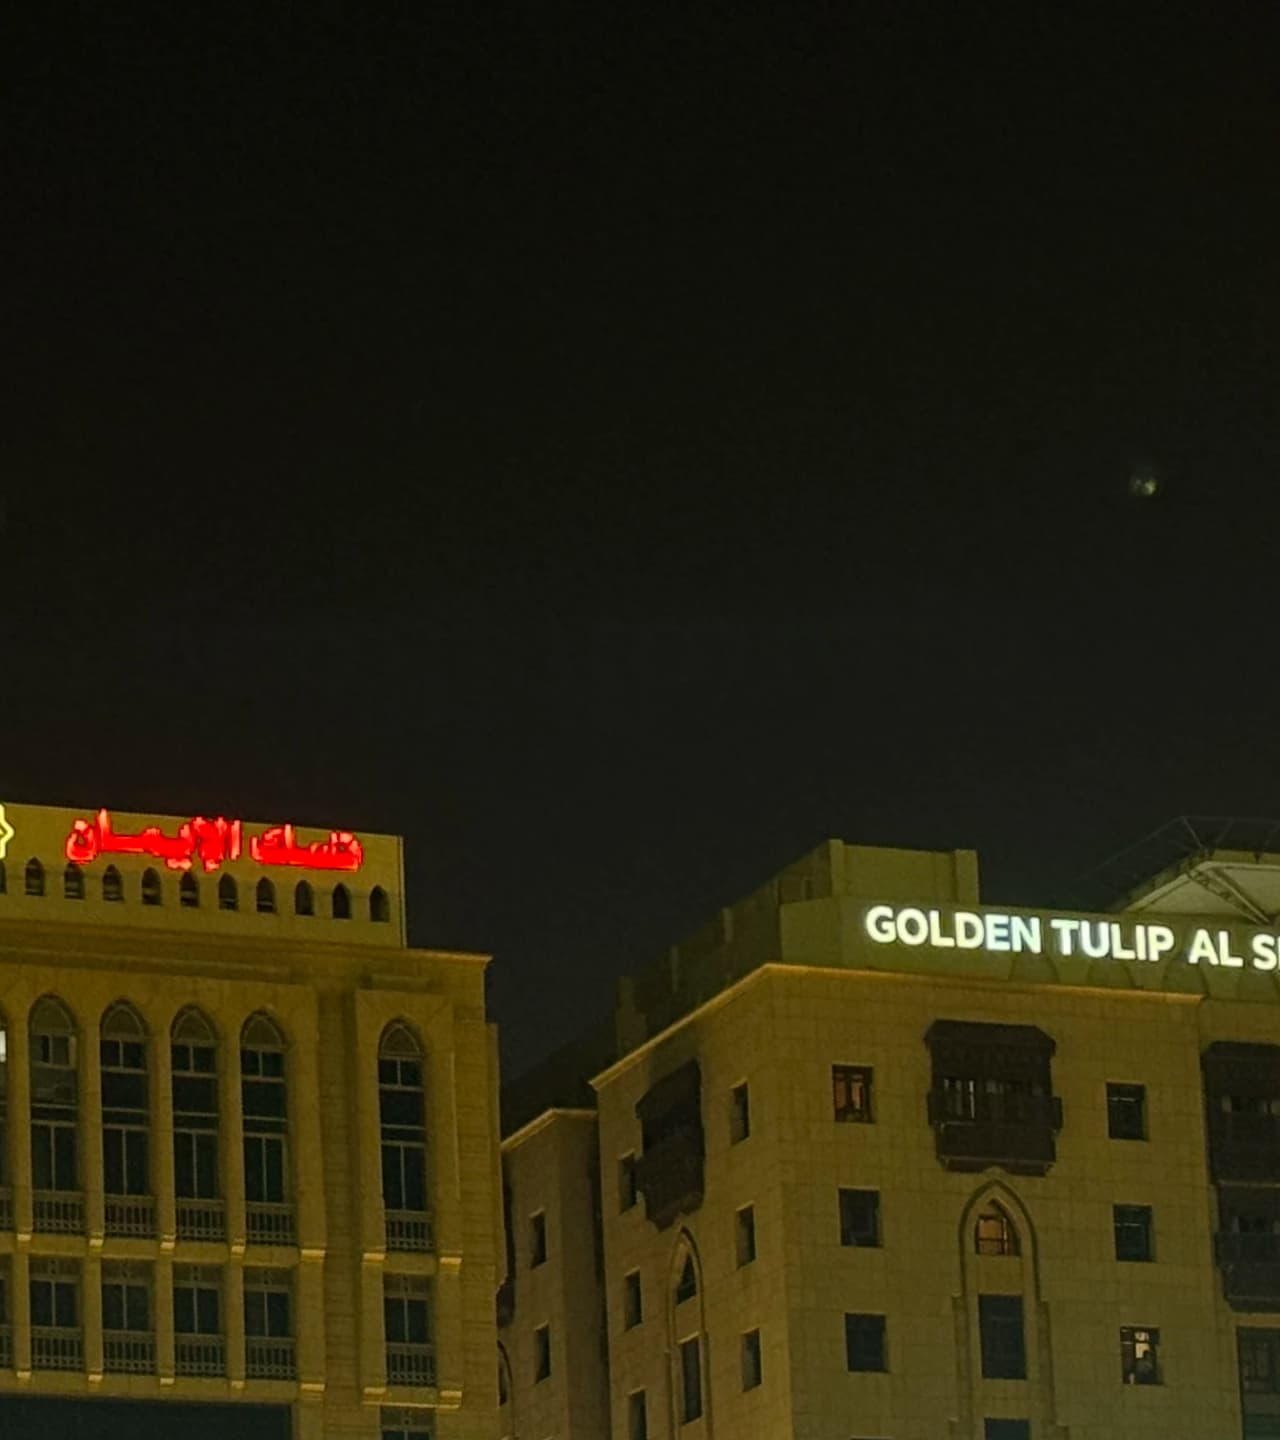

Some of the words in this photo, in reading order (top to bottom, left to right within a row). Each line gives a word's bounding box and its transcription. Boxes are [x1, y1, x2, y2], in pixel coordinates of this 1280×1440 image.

[866, 905, 1042, 954] GOLDEN
[1051, 919, 1175, 962] TULIP
[1188, 928, 1244, 968] AL
